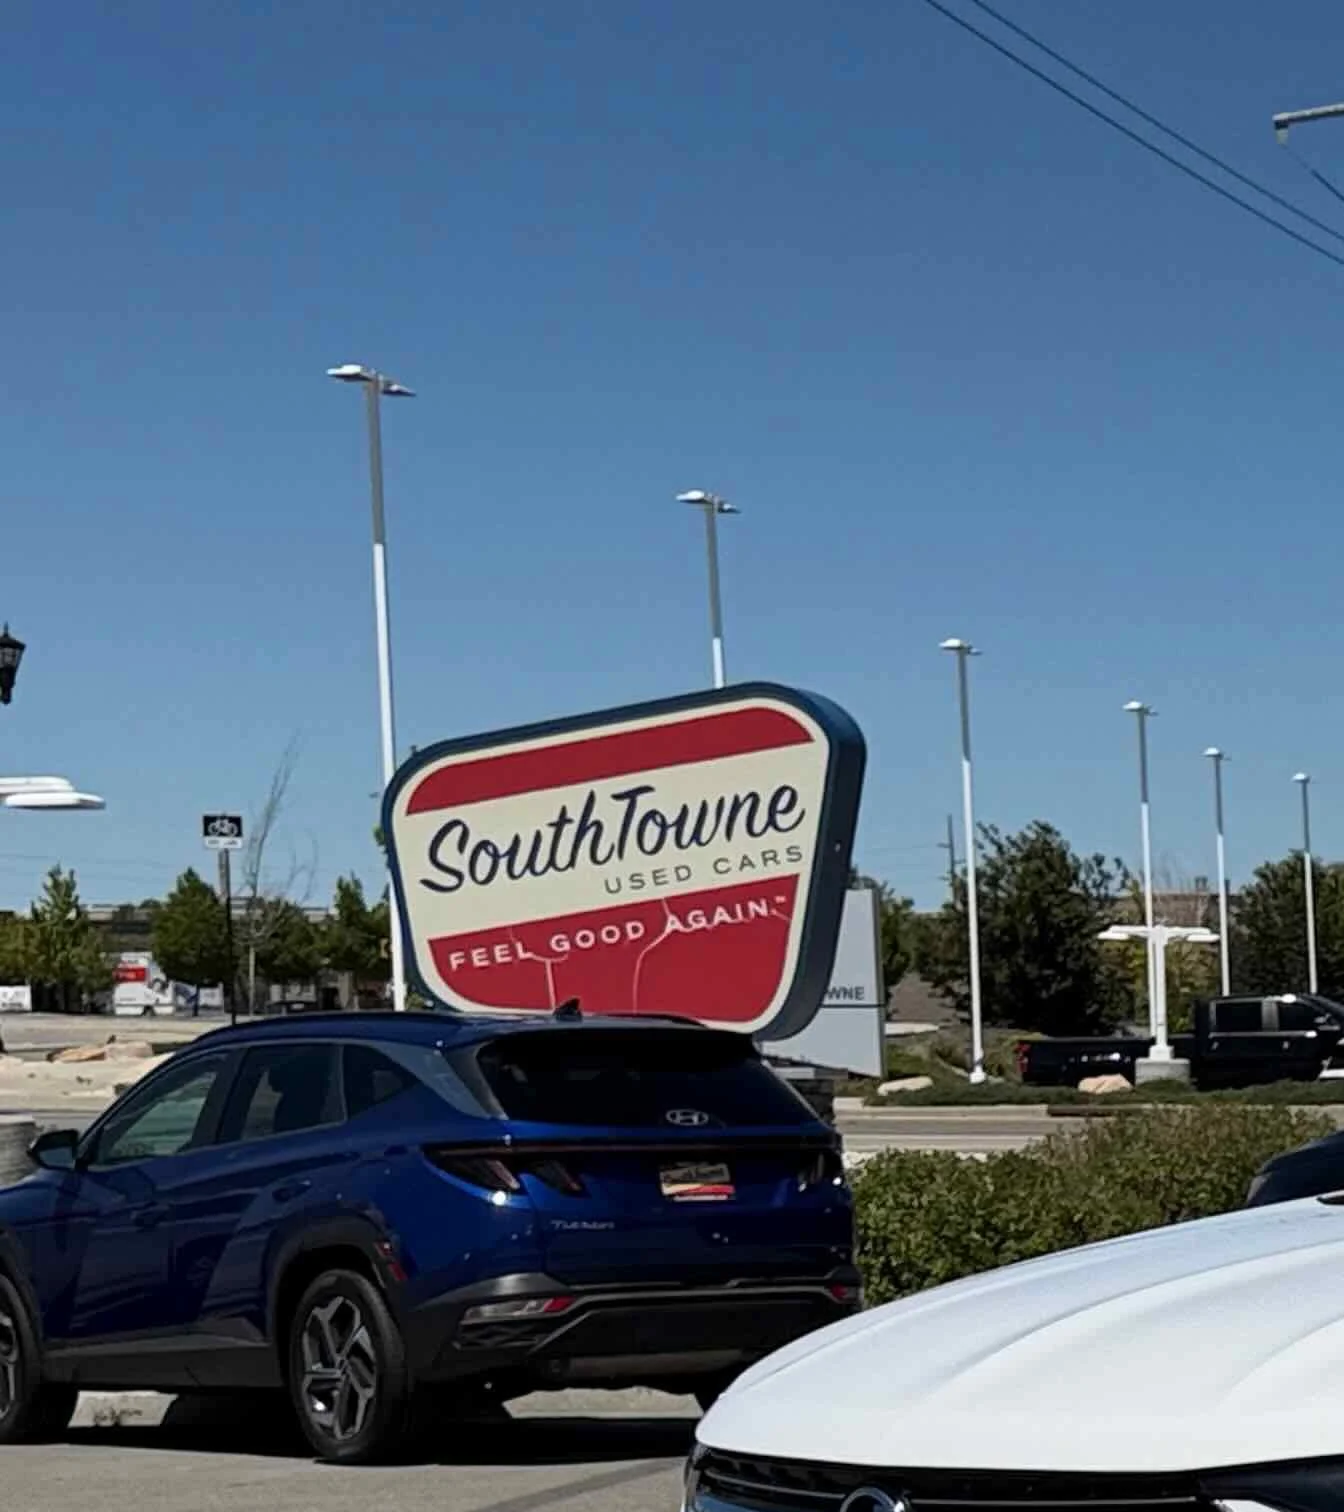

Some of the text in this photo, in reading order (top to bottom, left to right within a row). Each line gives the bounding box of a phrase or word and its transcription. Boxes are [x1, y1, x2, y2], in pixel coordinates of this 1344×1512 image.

[420, 784, 806, 894] SouthTowne
[604, 845, 803, 894] USED CARS
[448, 940, 533, 972] FEEL
[551, 921, 645, 952] GOOD
